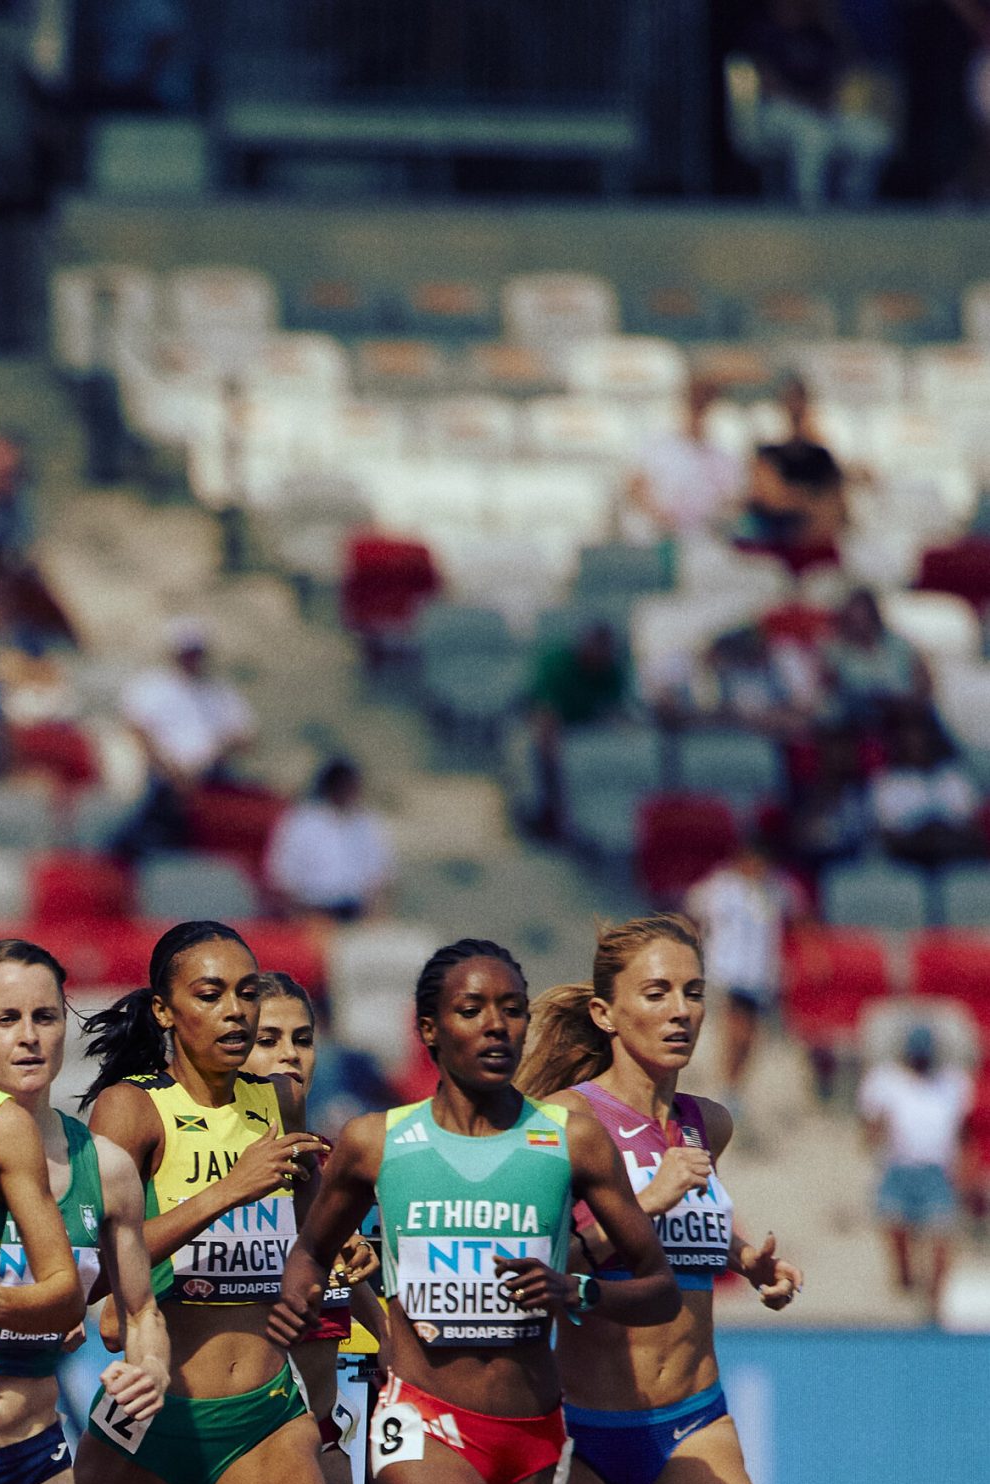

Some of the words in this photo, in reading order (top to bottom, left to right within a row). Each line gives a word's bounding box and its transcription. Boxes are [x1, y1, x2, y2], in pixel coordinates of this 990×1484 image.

[407, 1200, 539, 1233] ETHIOPIA
[188, 1239, 289, 1273] TRACEY
[406, 1281, 528, 1315] MESHES
